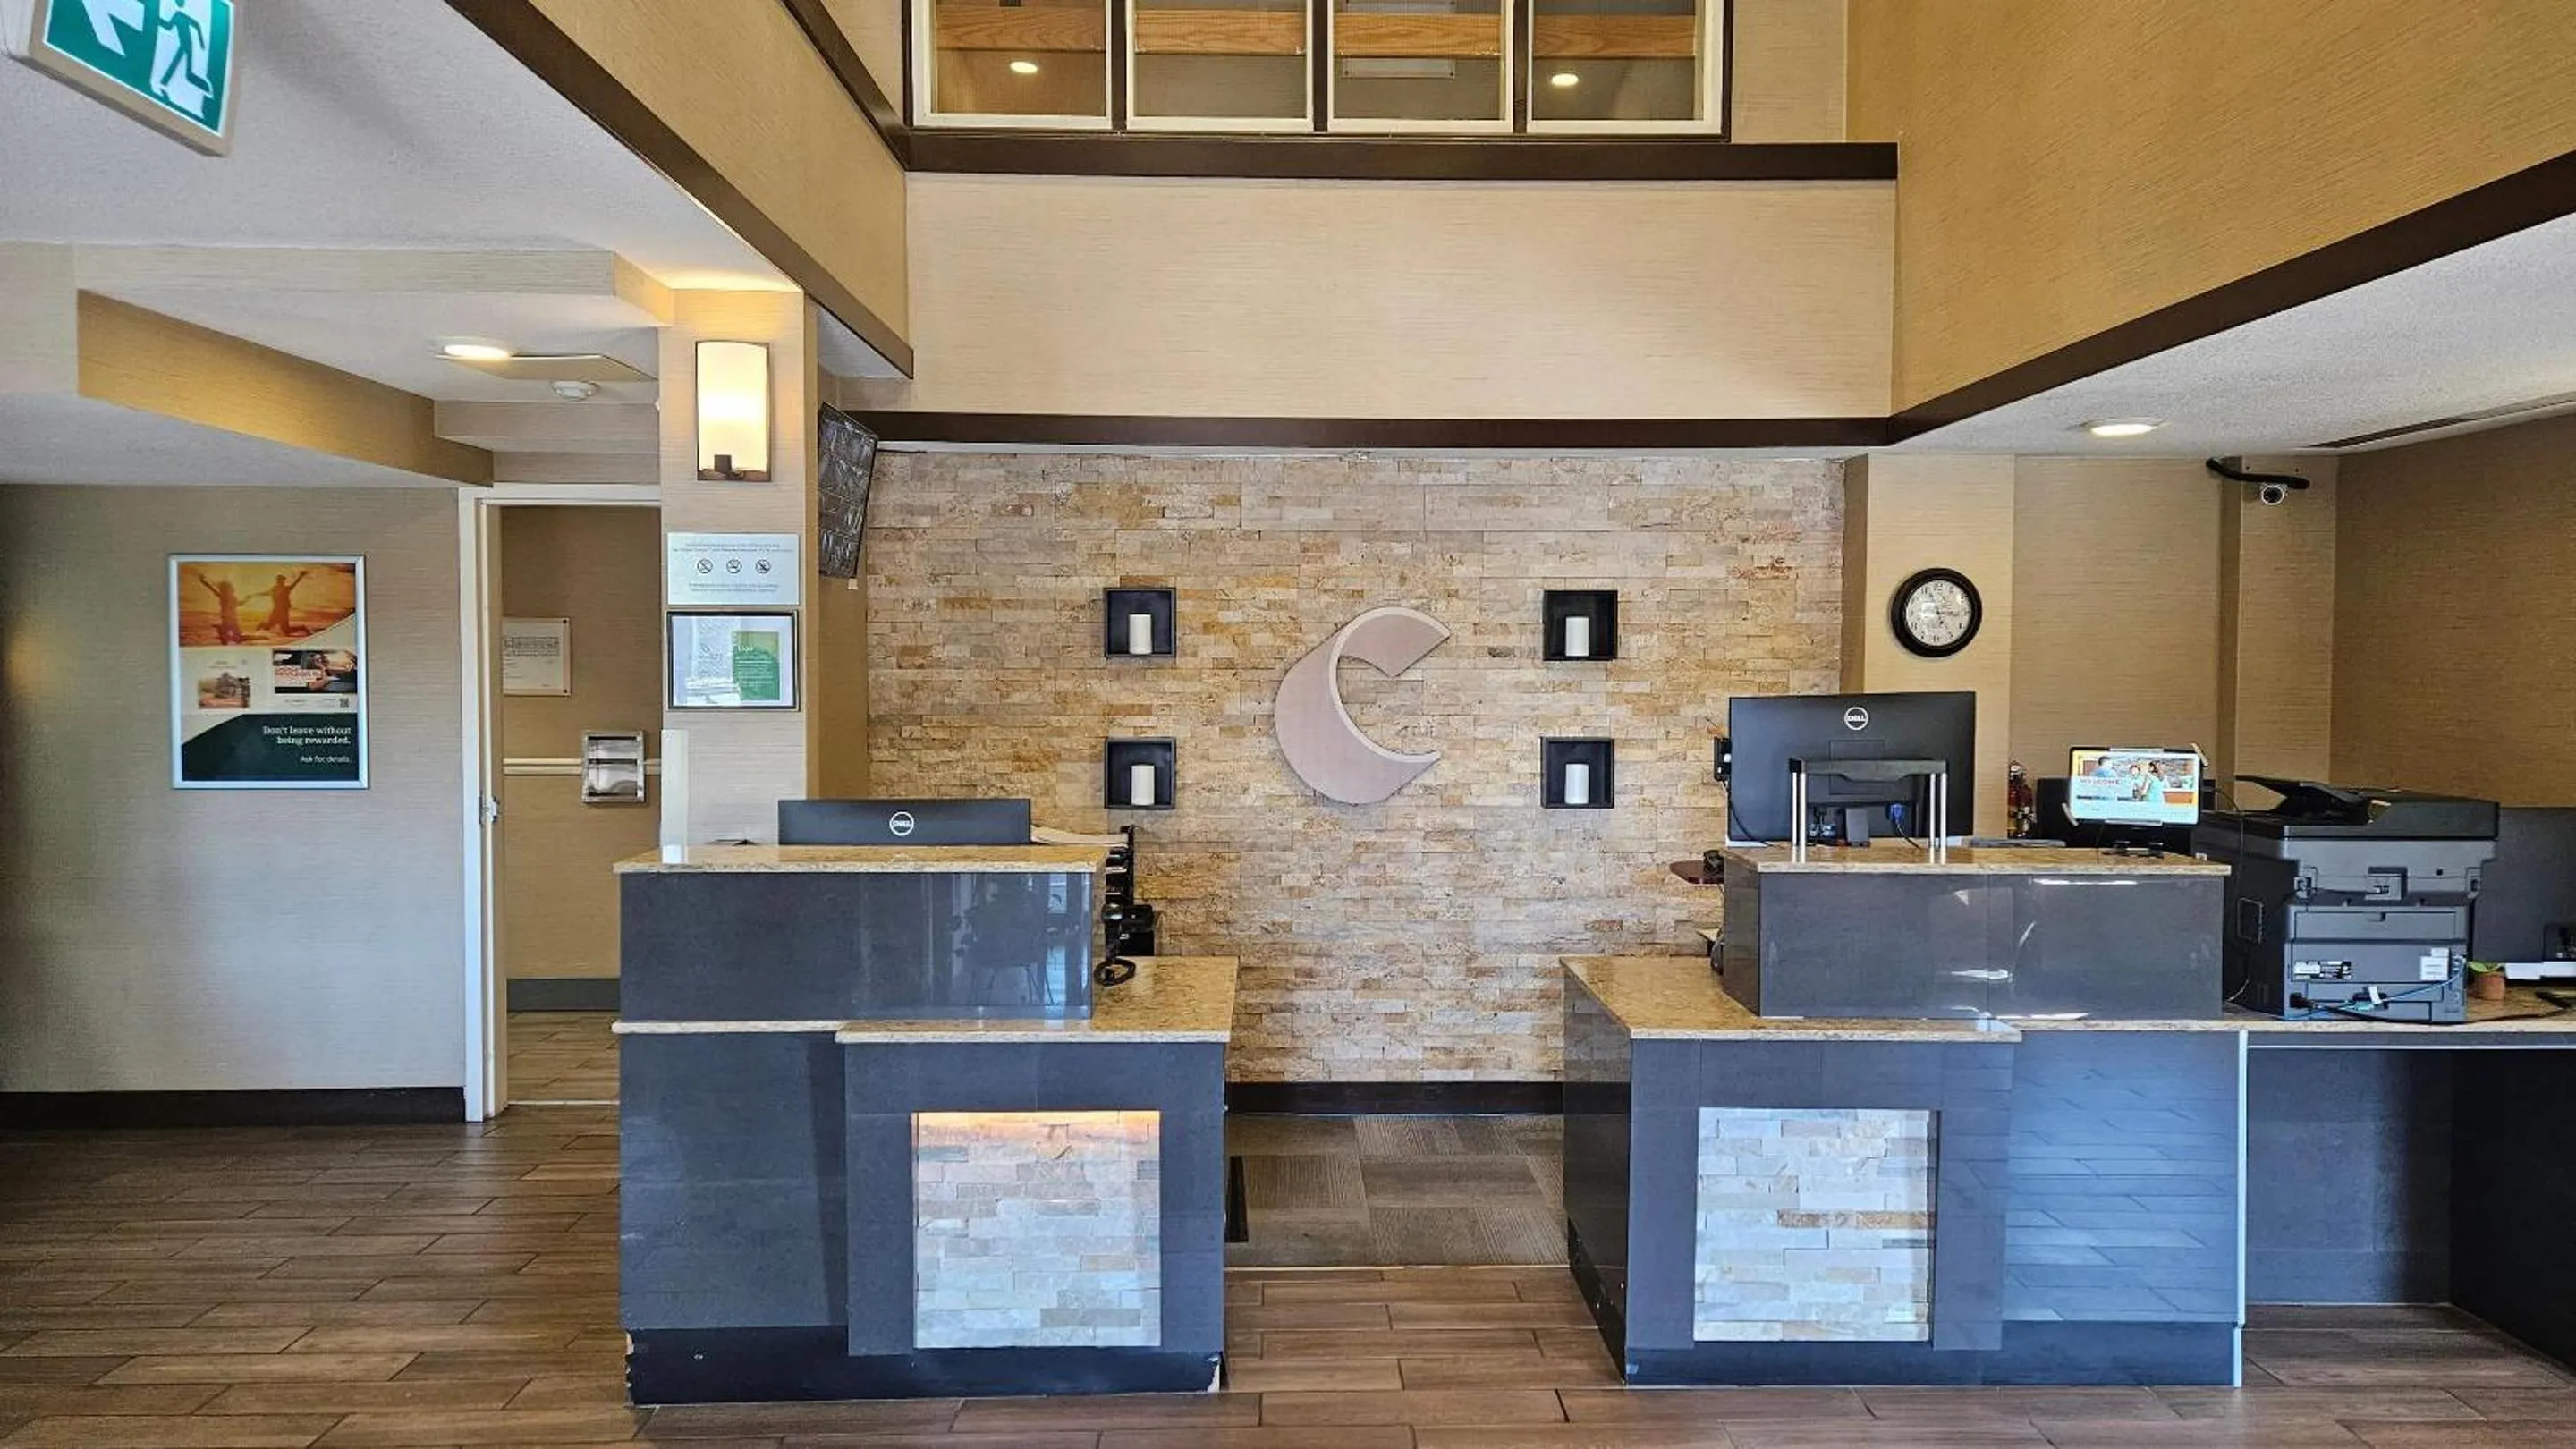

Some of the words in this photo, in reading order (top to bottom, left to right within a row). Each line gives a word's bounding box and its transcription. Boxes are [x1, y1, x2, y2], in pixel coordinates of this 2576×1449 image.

[263, 725, 287, 735] Don't
[289, 725, 314, 734] leave
[316, 725, 351, 734] without
[276, 736, 303, 746] being
[314, 755, 326, 763] for
